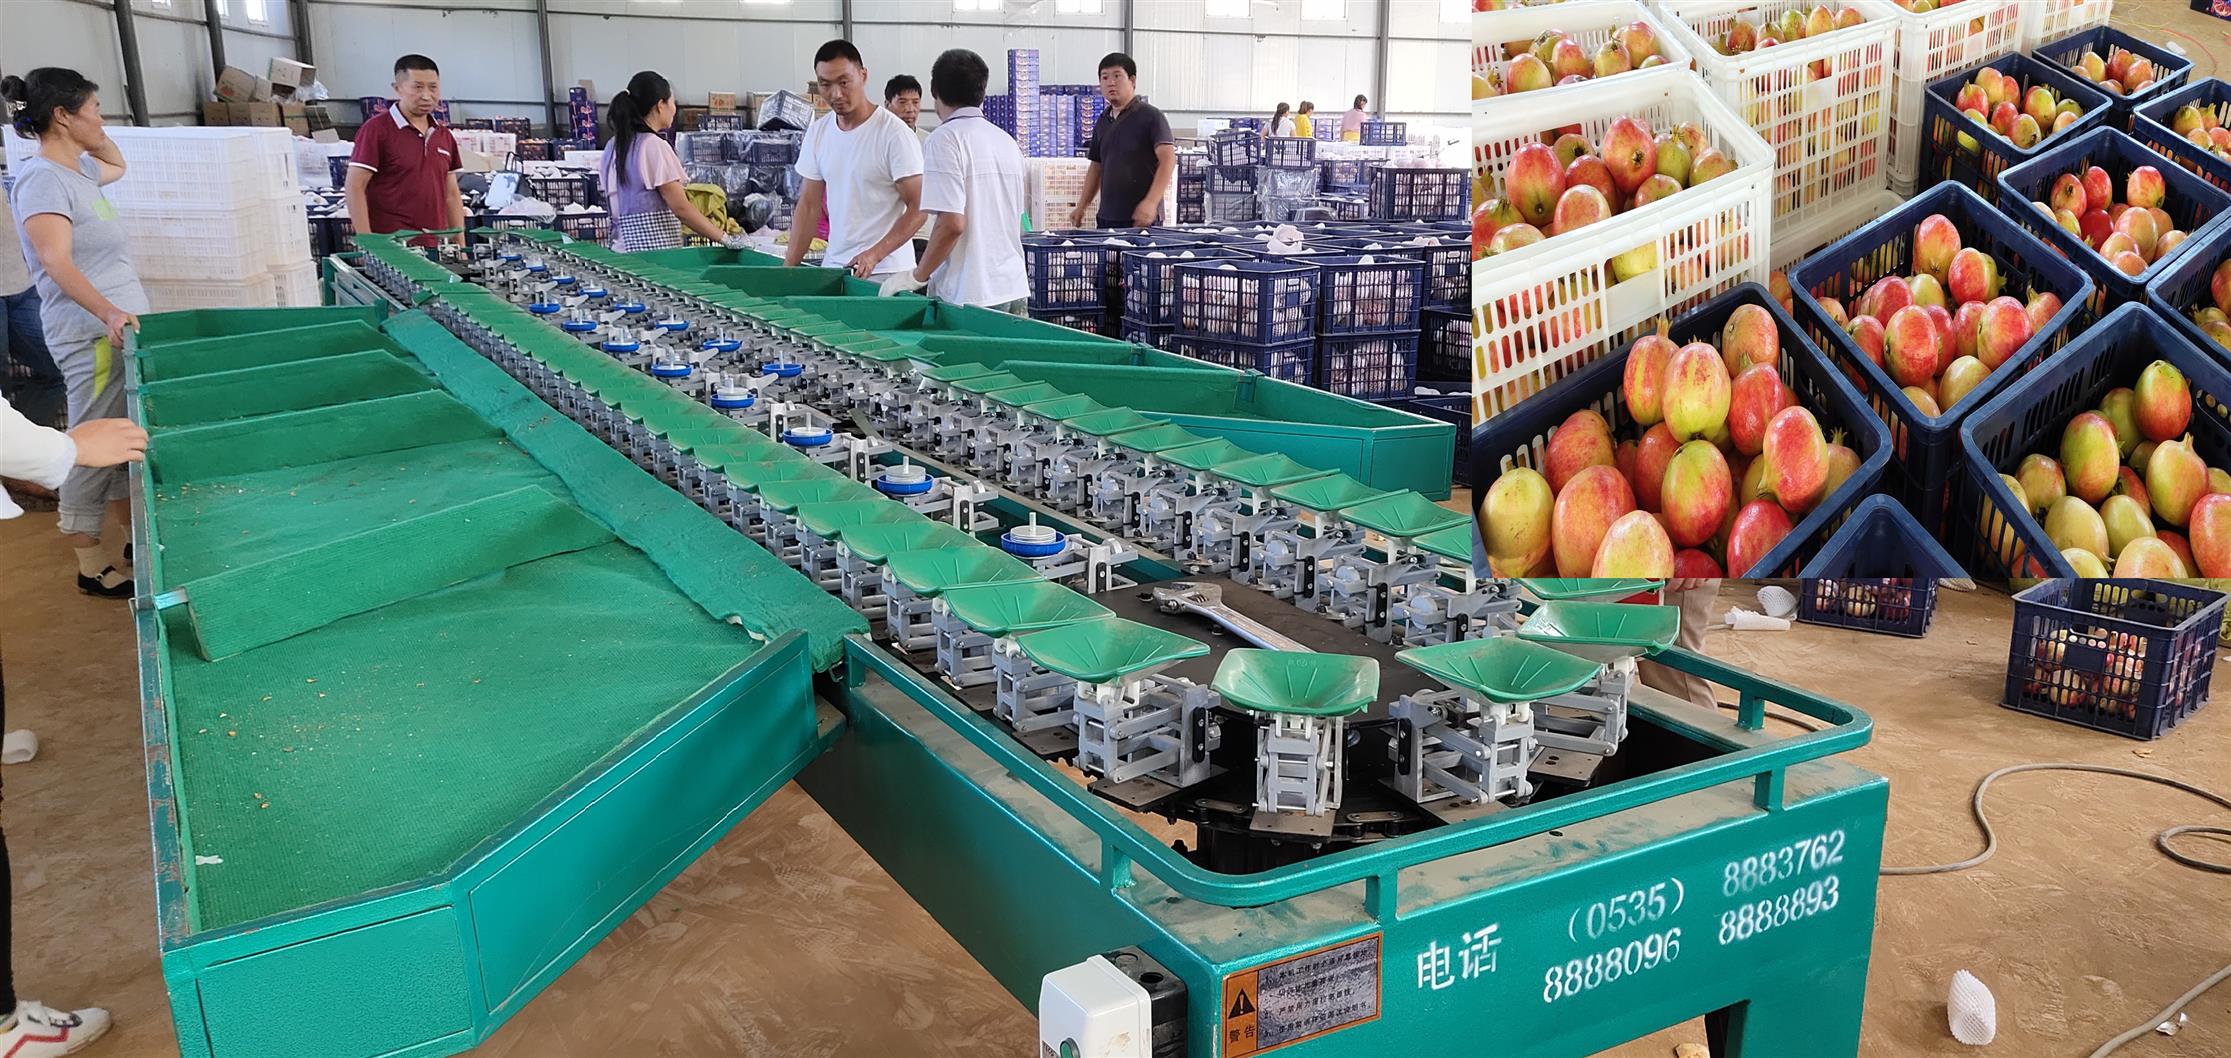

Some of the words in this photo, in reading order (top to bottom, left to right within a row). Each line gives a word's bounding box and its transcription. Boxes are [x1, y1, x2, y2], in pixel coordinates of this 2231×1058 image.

[1723, 829, 1845, 897] 8883762
[1417, 923, 1502, 991] 电话
[1543, 926, 1682, 1003] 8888096
[1718, 875, 1840, 945] 8888893
